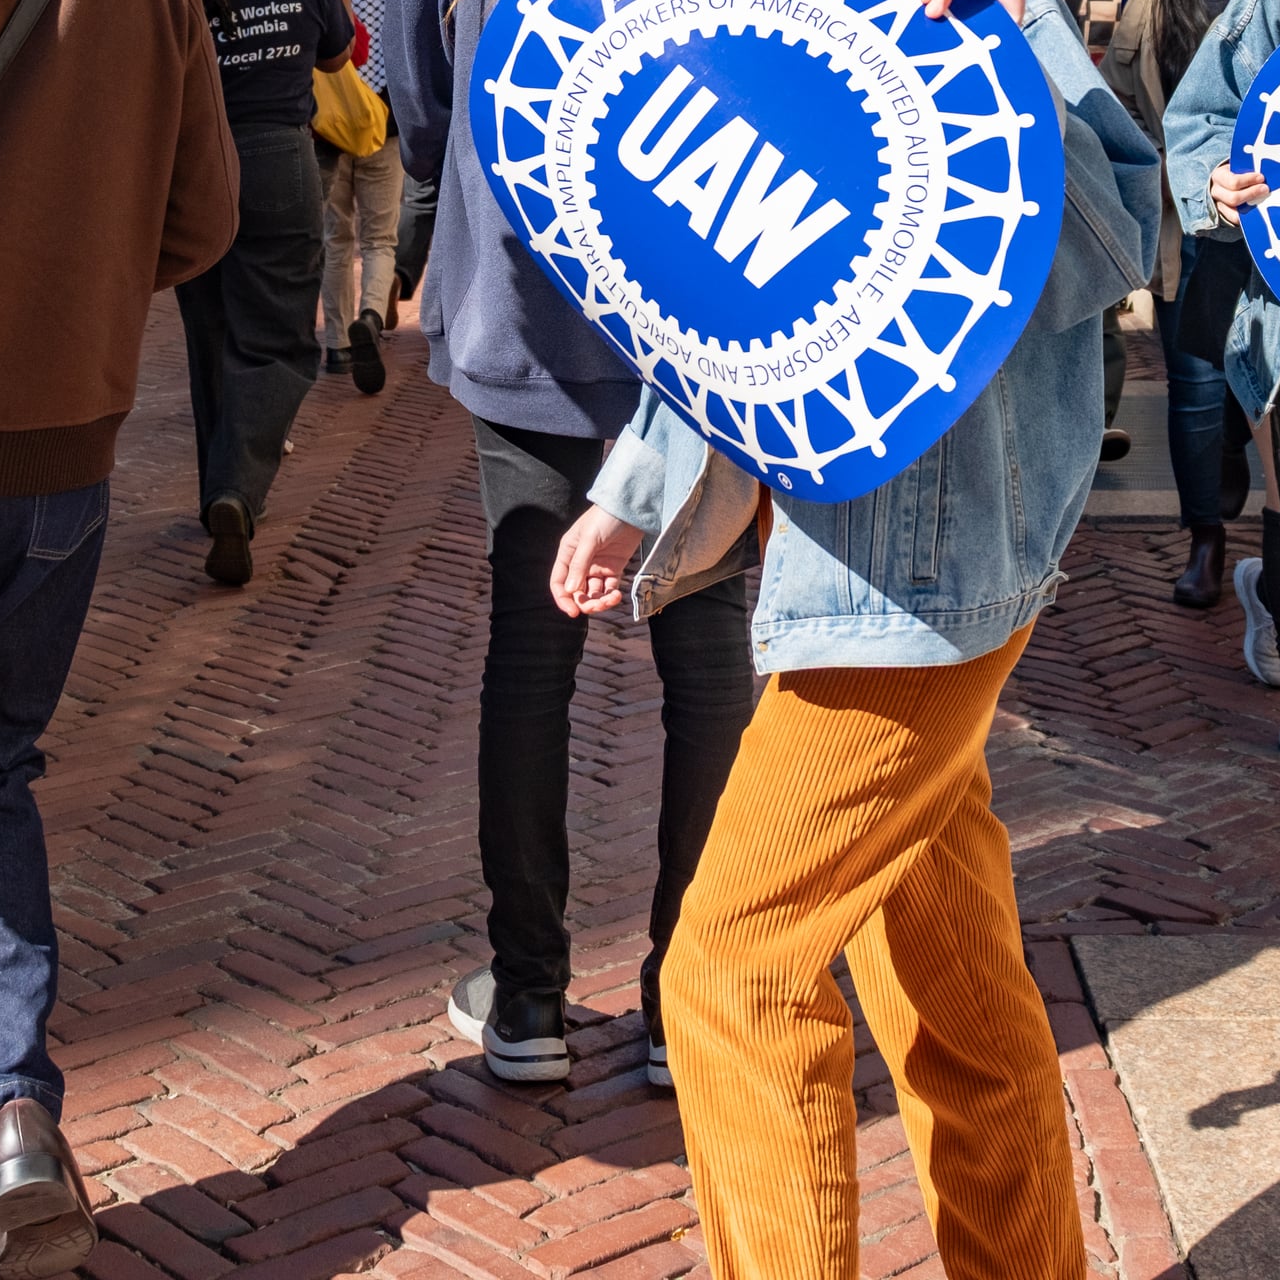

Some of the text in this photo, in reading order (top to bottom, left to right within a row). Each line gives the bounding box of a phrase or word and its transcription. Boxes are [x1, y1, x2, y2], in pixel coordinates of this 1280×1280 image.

[240, 1, 302, 21] Workers
[223, 48, 263, 66] Local
[265, 44, 301, 60] 2710
[859, 45, 920, 126] UNITED
[555, 66, 594, 214] IMPLEMENT
[617, 64, 851, 290] UAW
[856, 135, 929, 304] AUTOMOBILE,
[573, 220, 692, 364] AGRICULTURAL
[698, 356, 738, 385] AND
[744, 304, 861, 386] AEROSPACE
